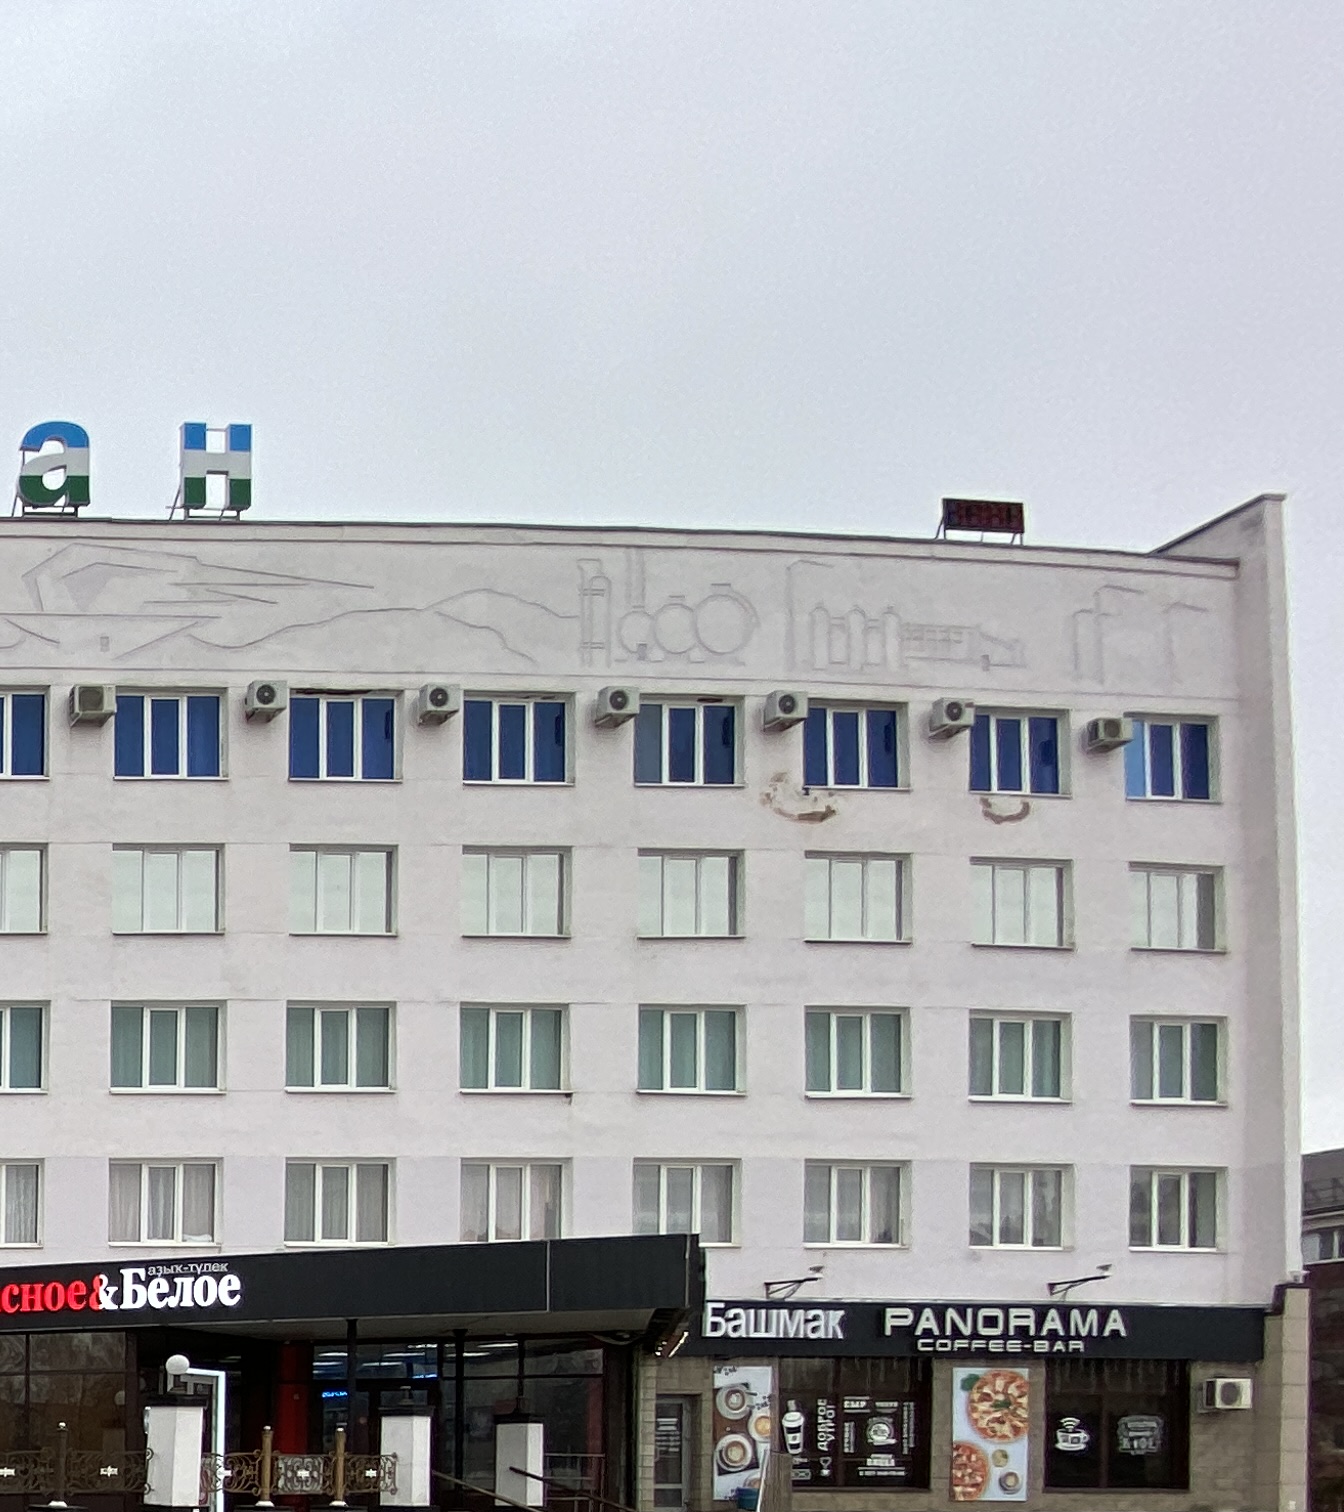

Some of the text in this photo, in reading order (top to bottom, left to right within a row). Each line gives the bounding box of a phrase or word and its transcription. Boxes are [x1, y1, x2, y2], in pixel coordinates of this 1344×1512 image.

[703, 1302, 845, 1339] Башмак
[884, 1308, 1127, 1337] PANORAMA
[917, 1339, 1085, 1352] COFFEE-BAR
